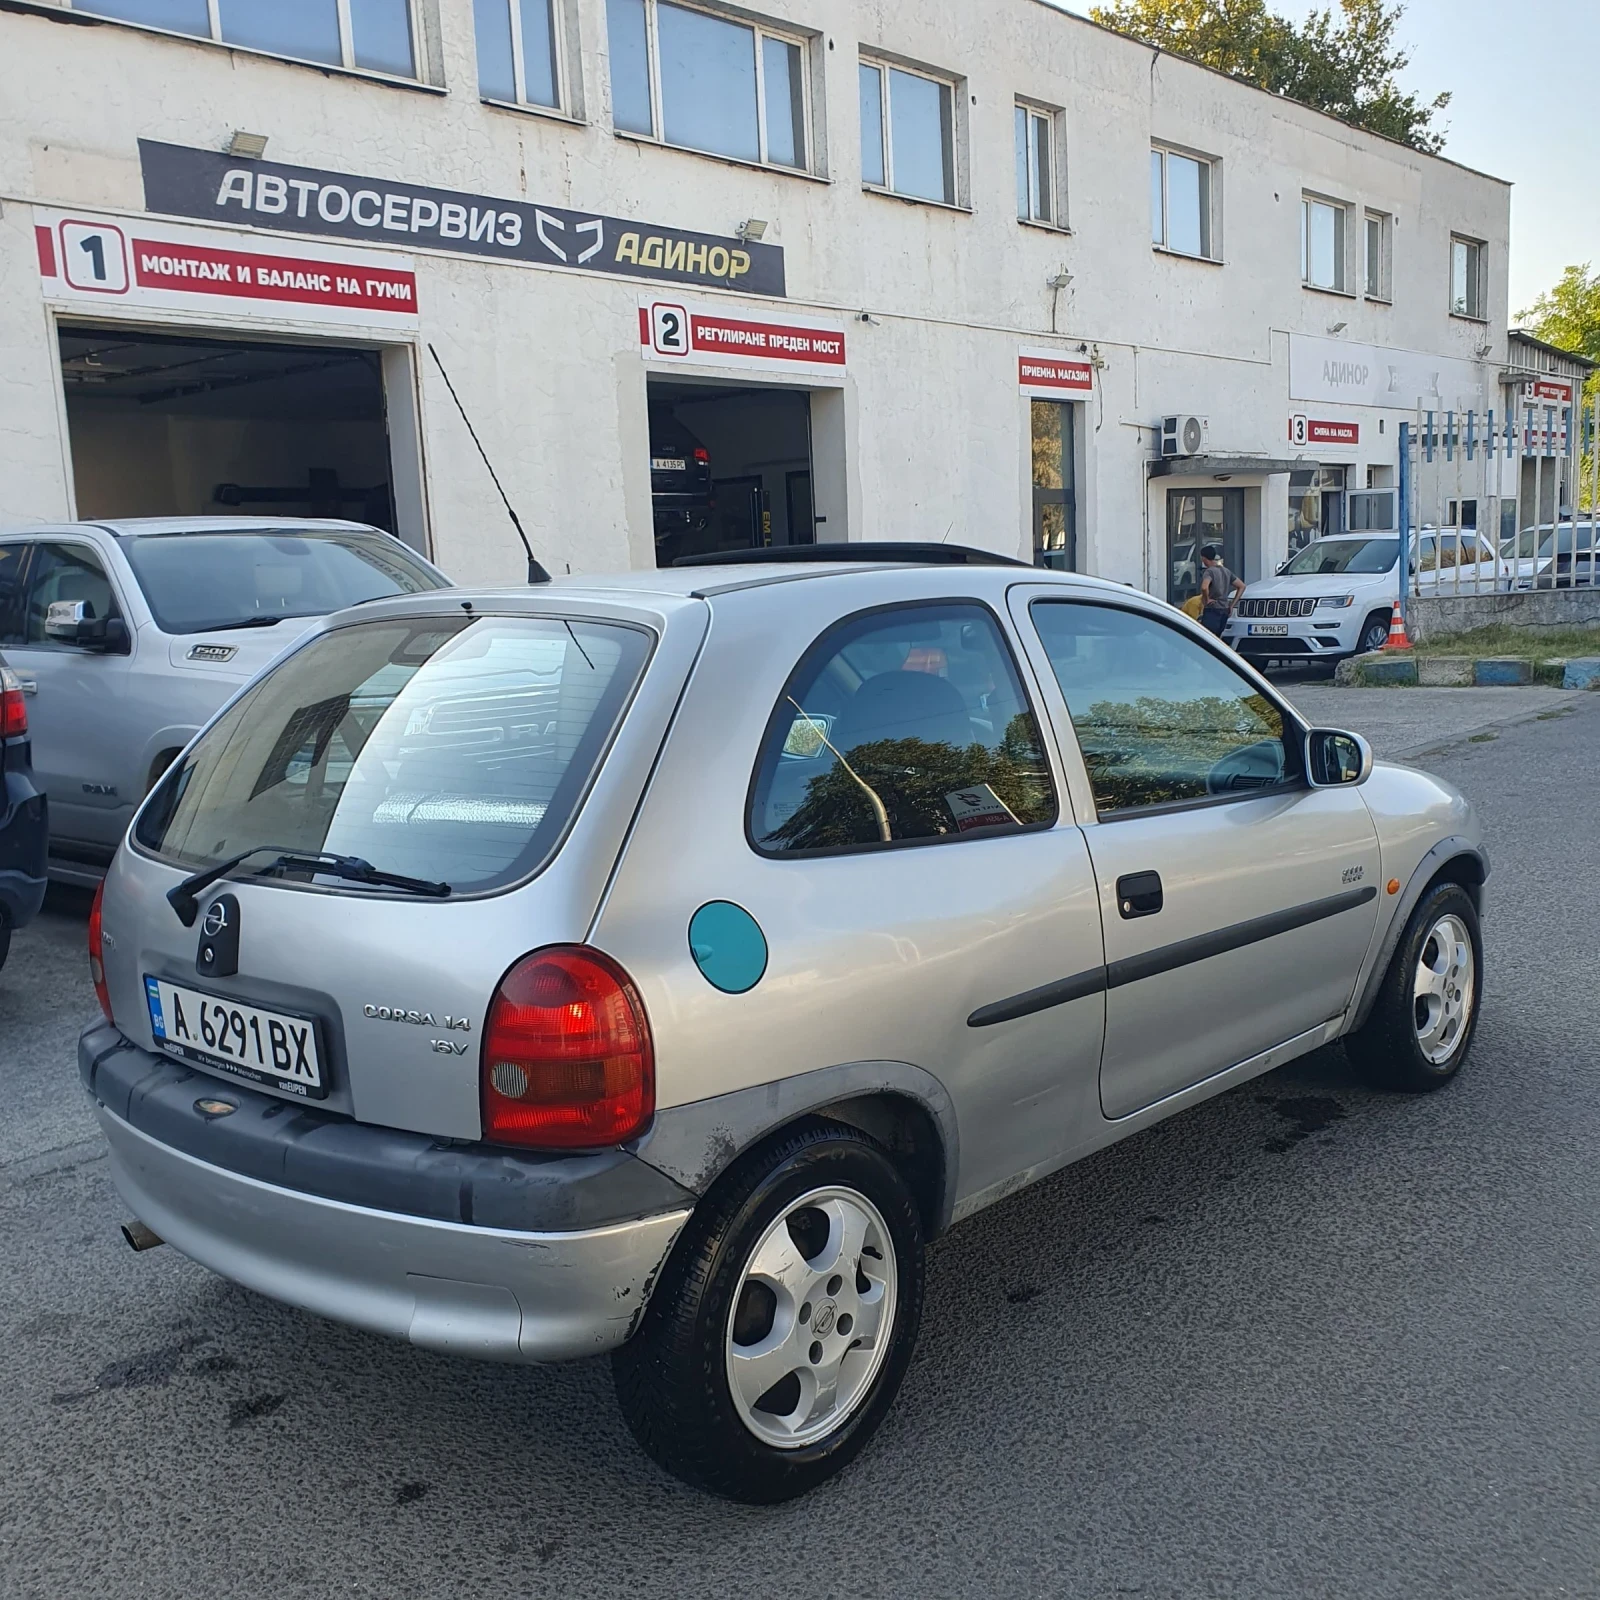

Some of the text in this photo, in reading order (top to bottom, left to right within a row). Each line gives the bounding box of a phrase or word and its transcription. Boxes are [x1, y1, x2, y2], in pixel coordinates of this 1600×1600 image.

[216, 169, 522, 247] АВТОСЕРВИЗ
[80, 235, 106, 281] 1
[614, 232, 751, 279] АДИНОР
[141, 254, 412, 301] МОНТАЖ И БАЛАНС НА ГУМИ
[662, 312, 680, 347] 2
[697, 325, 841, 355] РЕГУЛИРАНЕ ПРЕДЕН МОСТ
[1021, 364, 1090, 383] ПРИЕМНА МАГАЗИН
[1322, 359, 1370, 388] АДИНОР
[1296, 420, 1304, 441] 3
[196, 647, 230, 655] 1500
[153, 1013, 164, 1028] BG
[363, 1003, 437, 1028] CORSA
[430, 1039, 469, 1056] 16V
